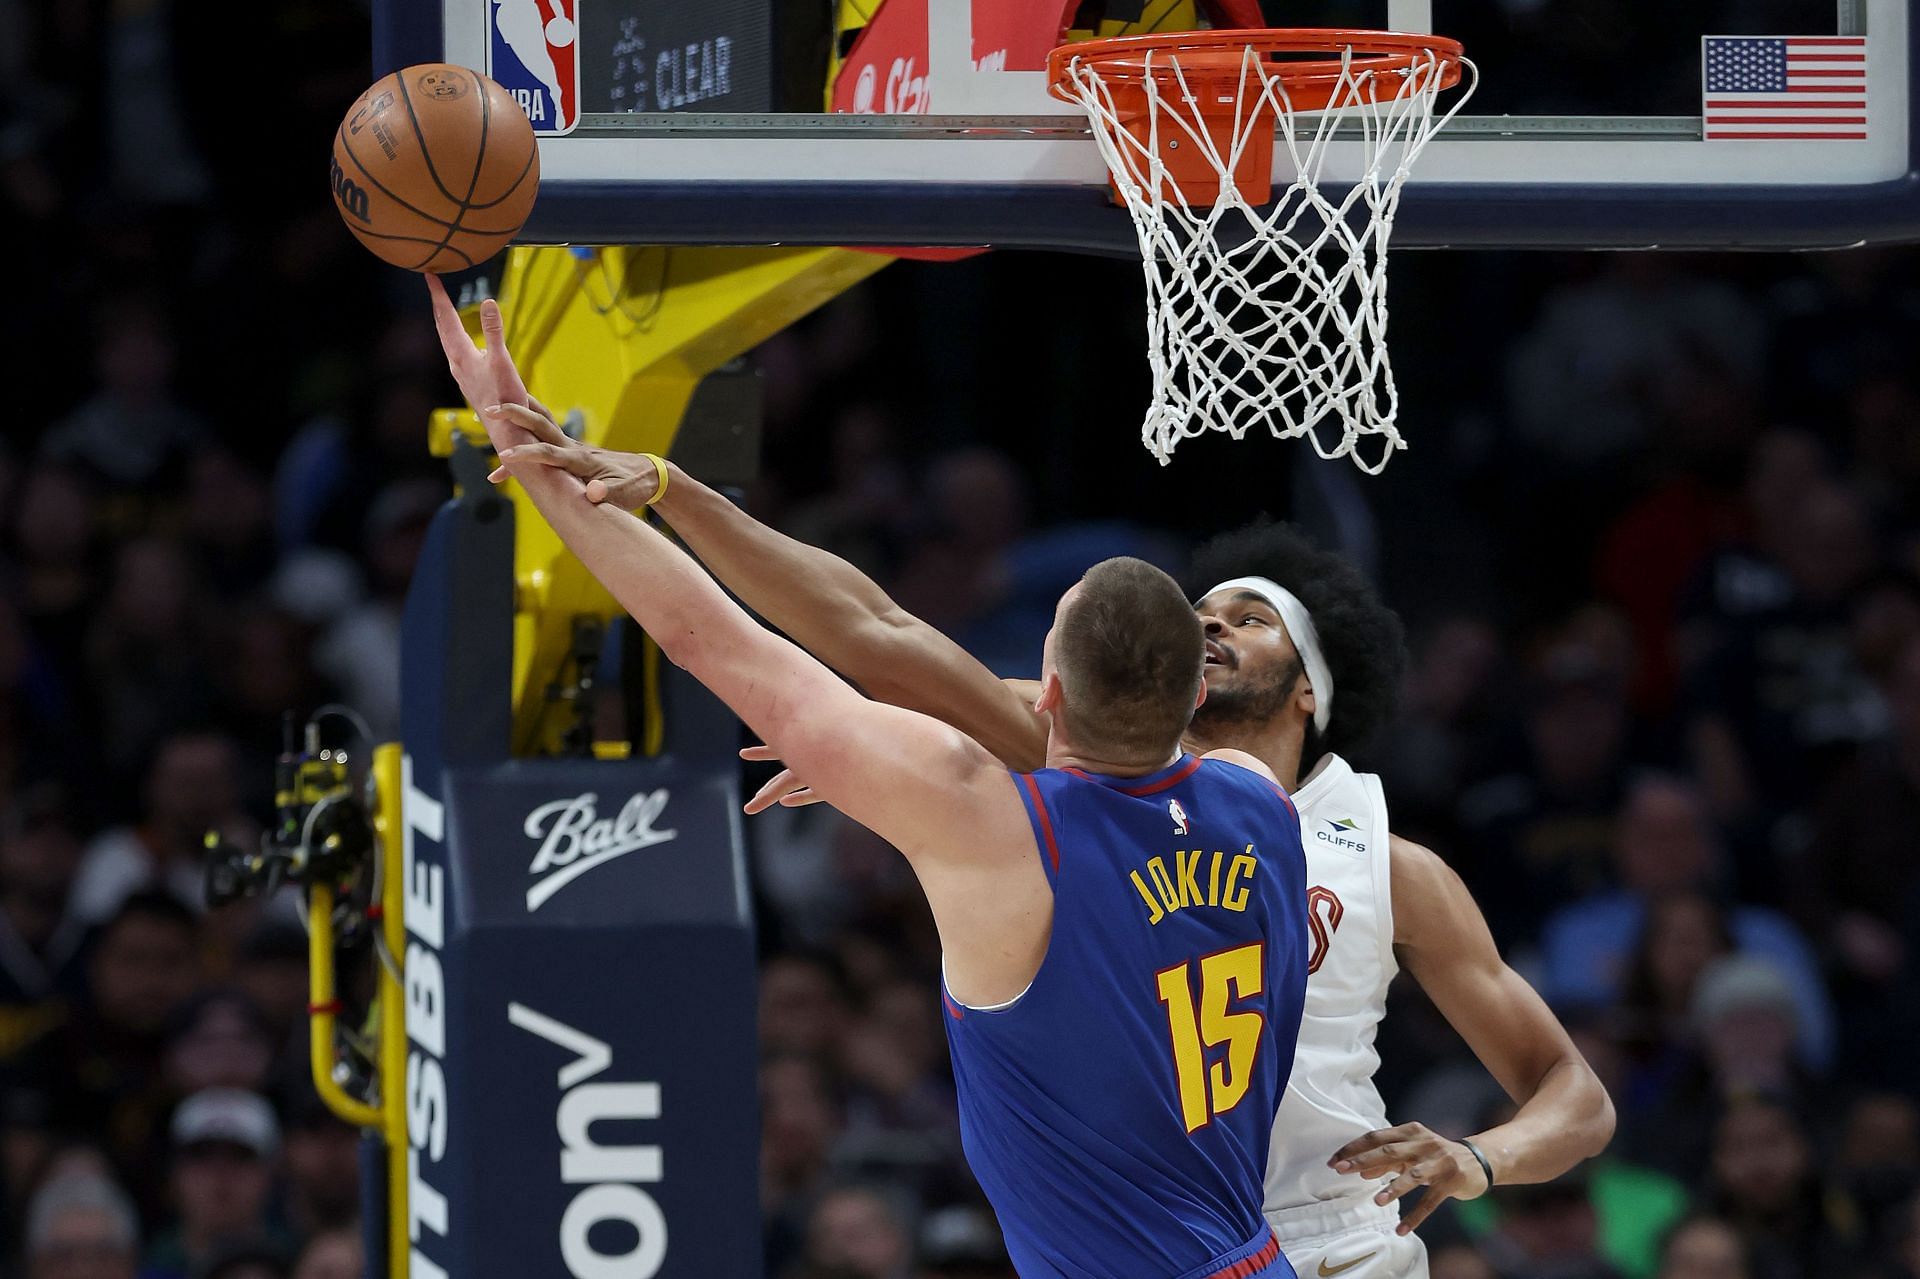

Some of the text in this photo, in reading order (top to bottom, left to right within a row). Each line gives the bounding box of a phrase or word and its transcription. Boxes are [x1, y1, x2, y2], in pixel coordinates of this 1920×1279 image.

[524, 788, 678, 875] Ball
[1317, 831, 1366, 853] CLIFFS
[1129, 844, 1257, 926] JOKIĆ
[402, 753, 449, 1279] TSBET
[1156, 941, 1264, 1135] 15
